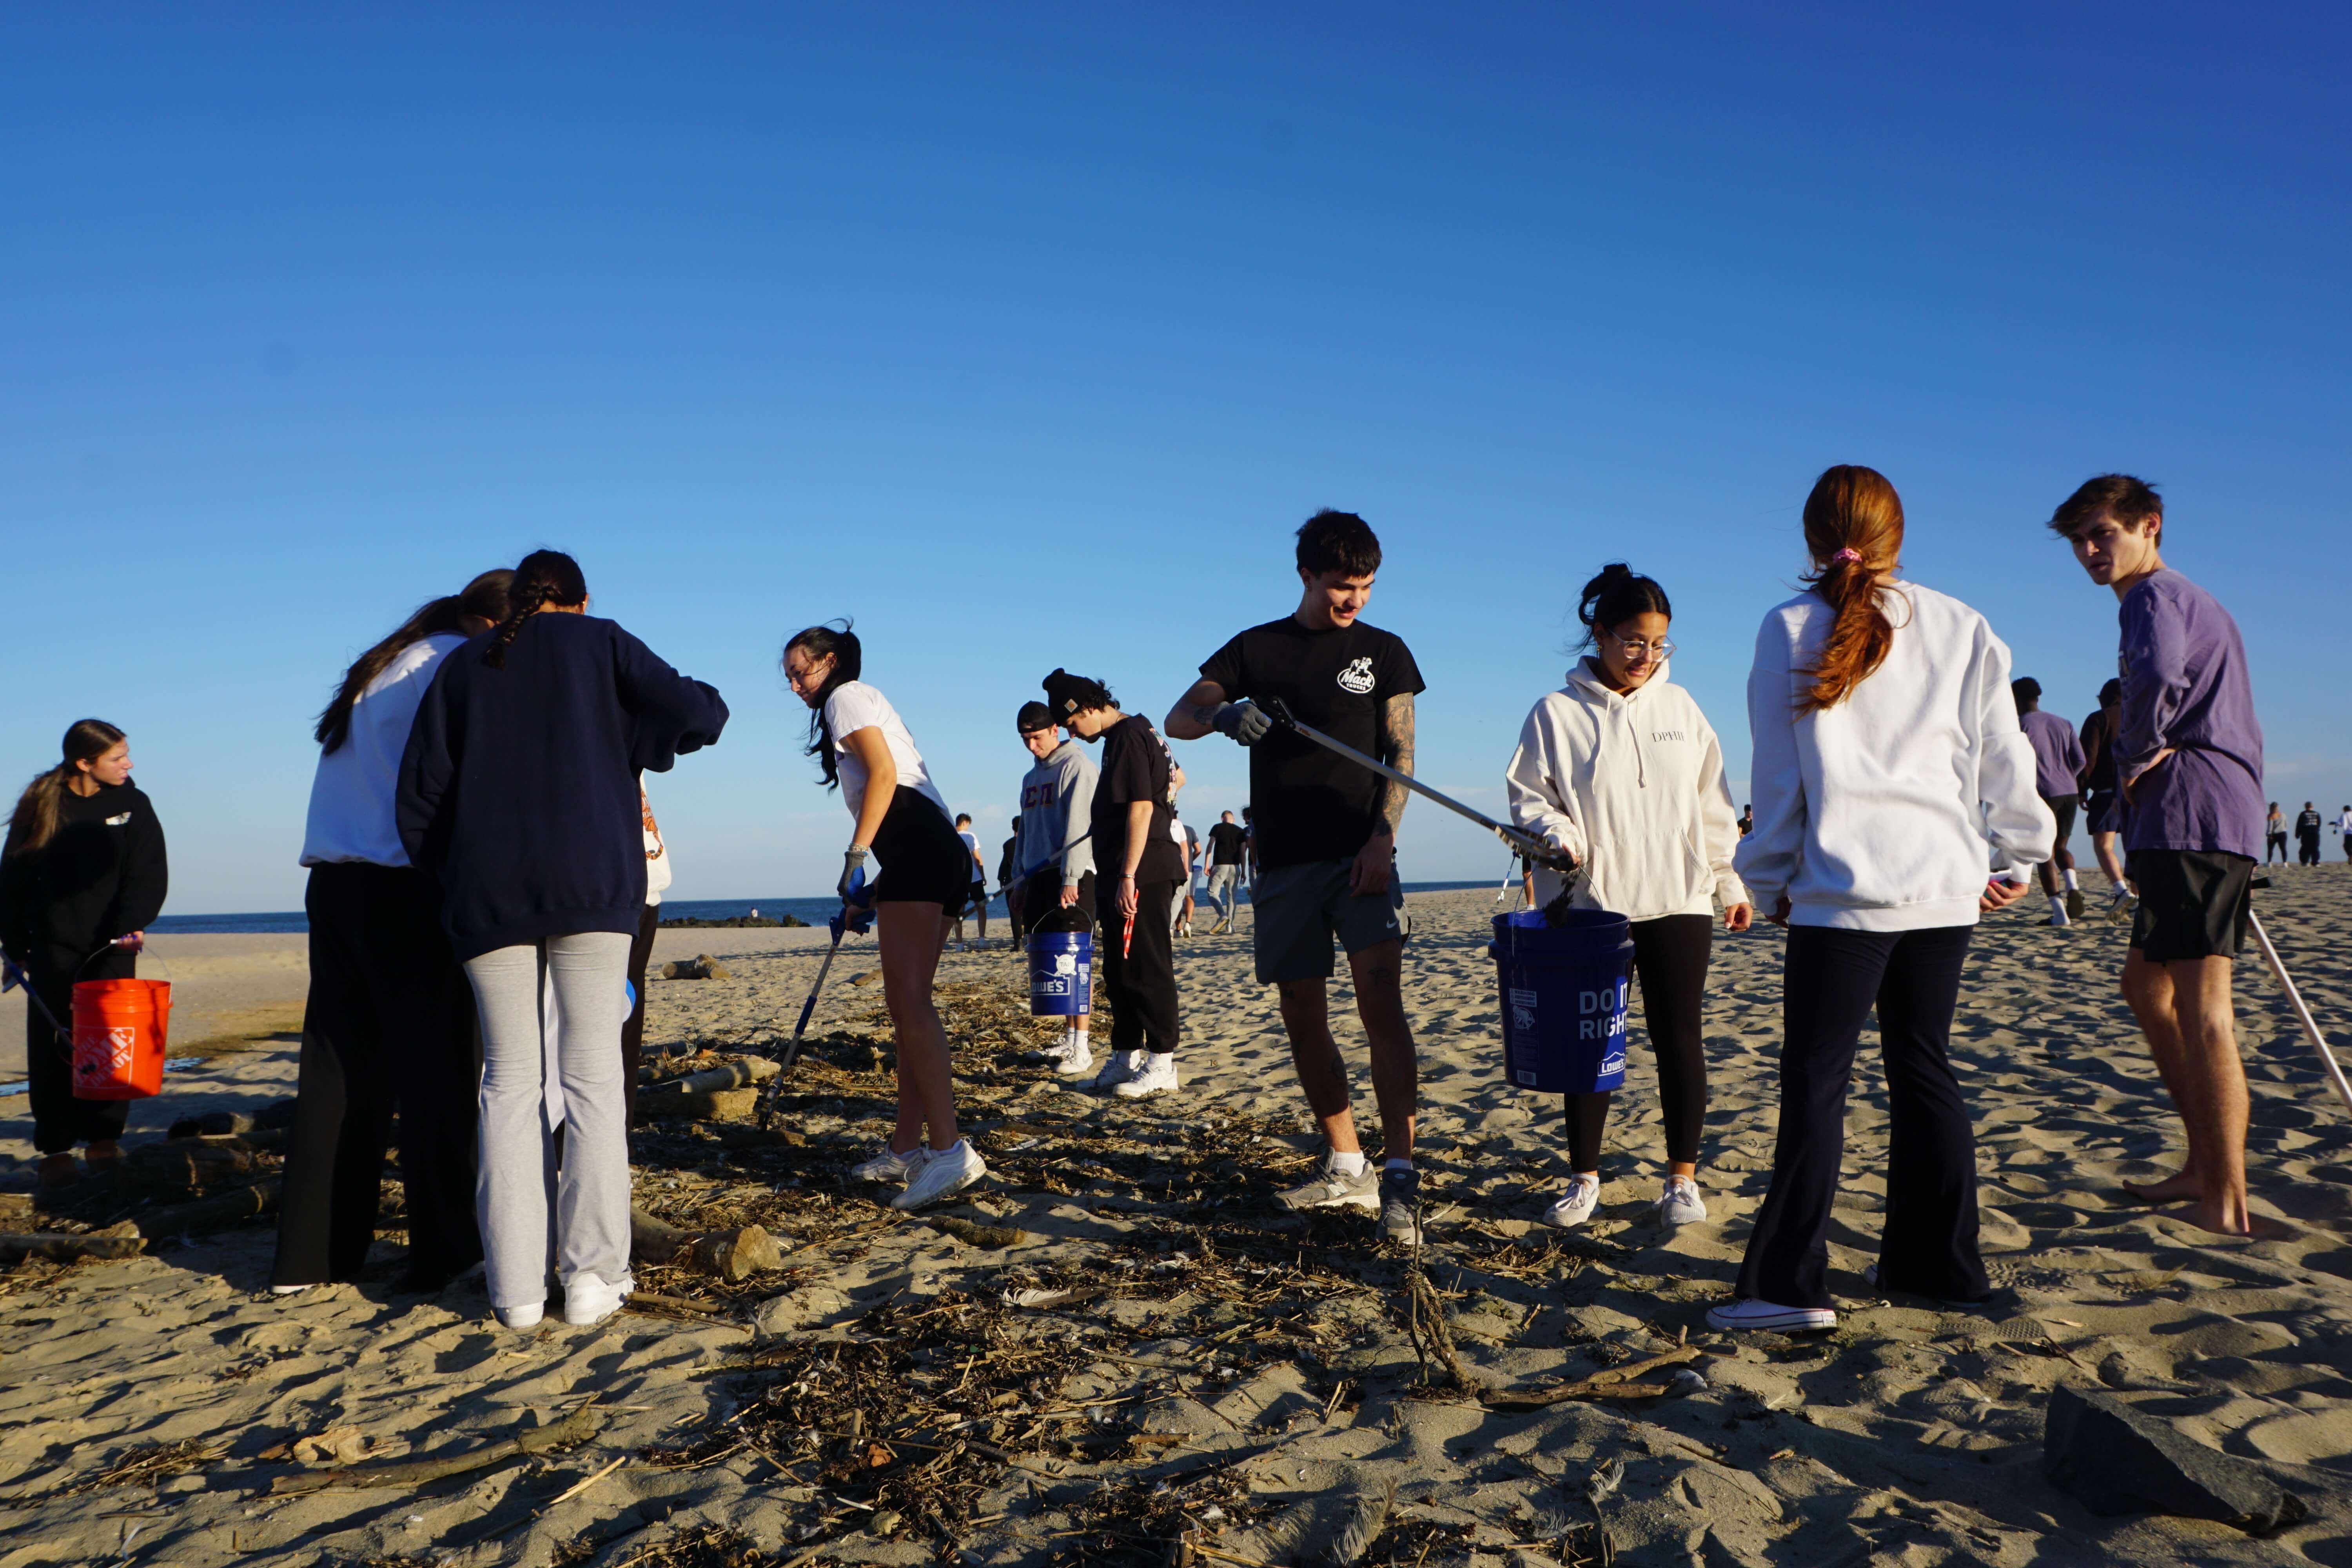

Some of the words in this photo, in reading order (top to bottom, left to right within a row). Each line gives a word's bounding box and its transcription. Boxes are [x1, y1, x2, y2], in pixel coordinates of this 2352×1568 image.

[1340, 671, 1373, 688] Mack
[1031, 979, 1064, 992] OWE'S
[1579, 988, 1615, 1014] DO
[1620, 982, 1628, 1008] IT
[1580, 1010, 1627, 1040] RIGHT
[74, 1028, 132, 1085] HOME
[90, 1050, 131, 1086] DEPOT
[1602, 1057, 1624, 1073] LOWE'S
